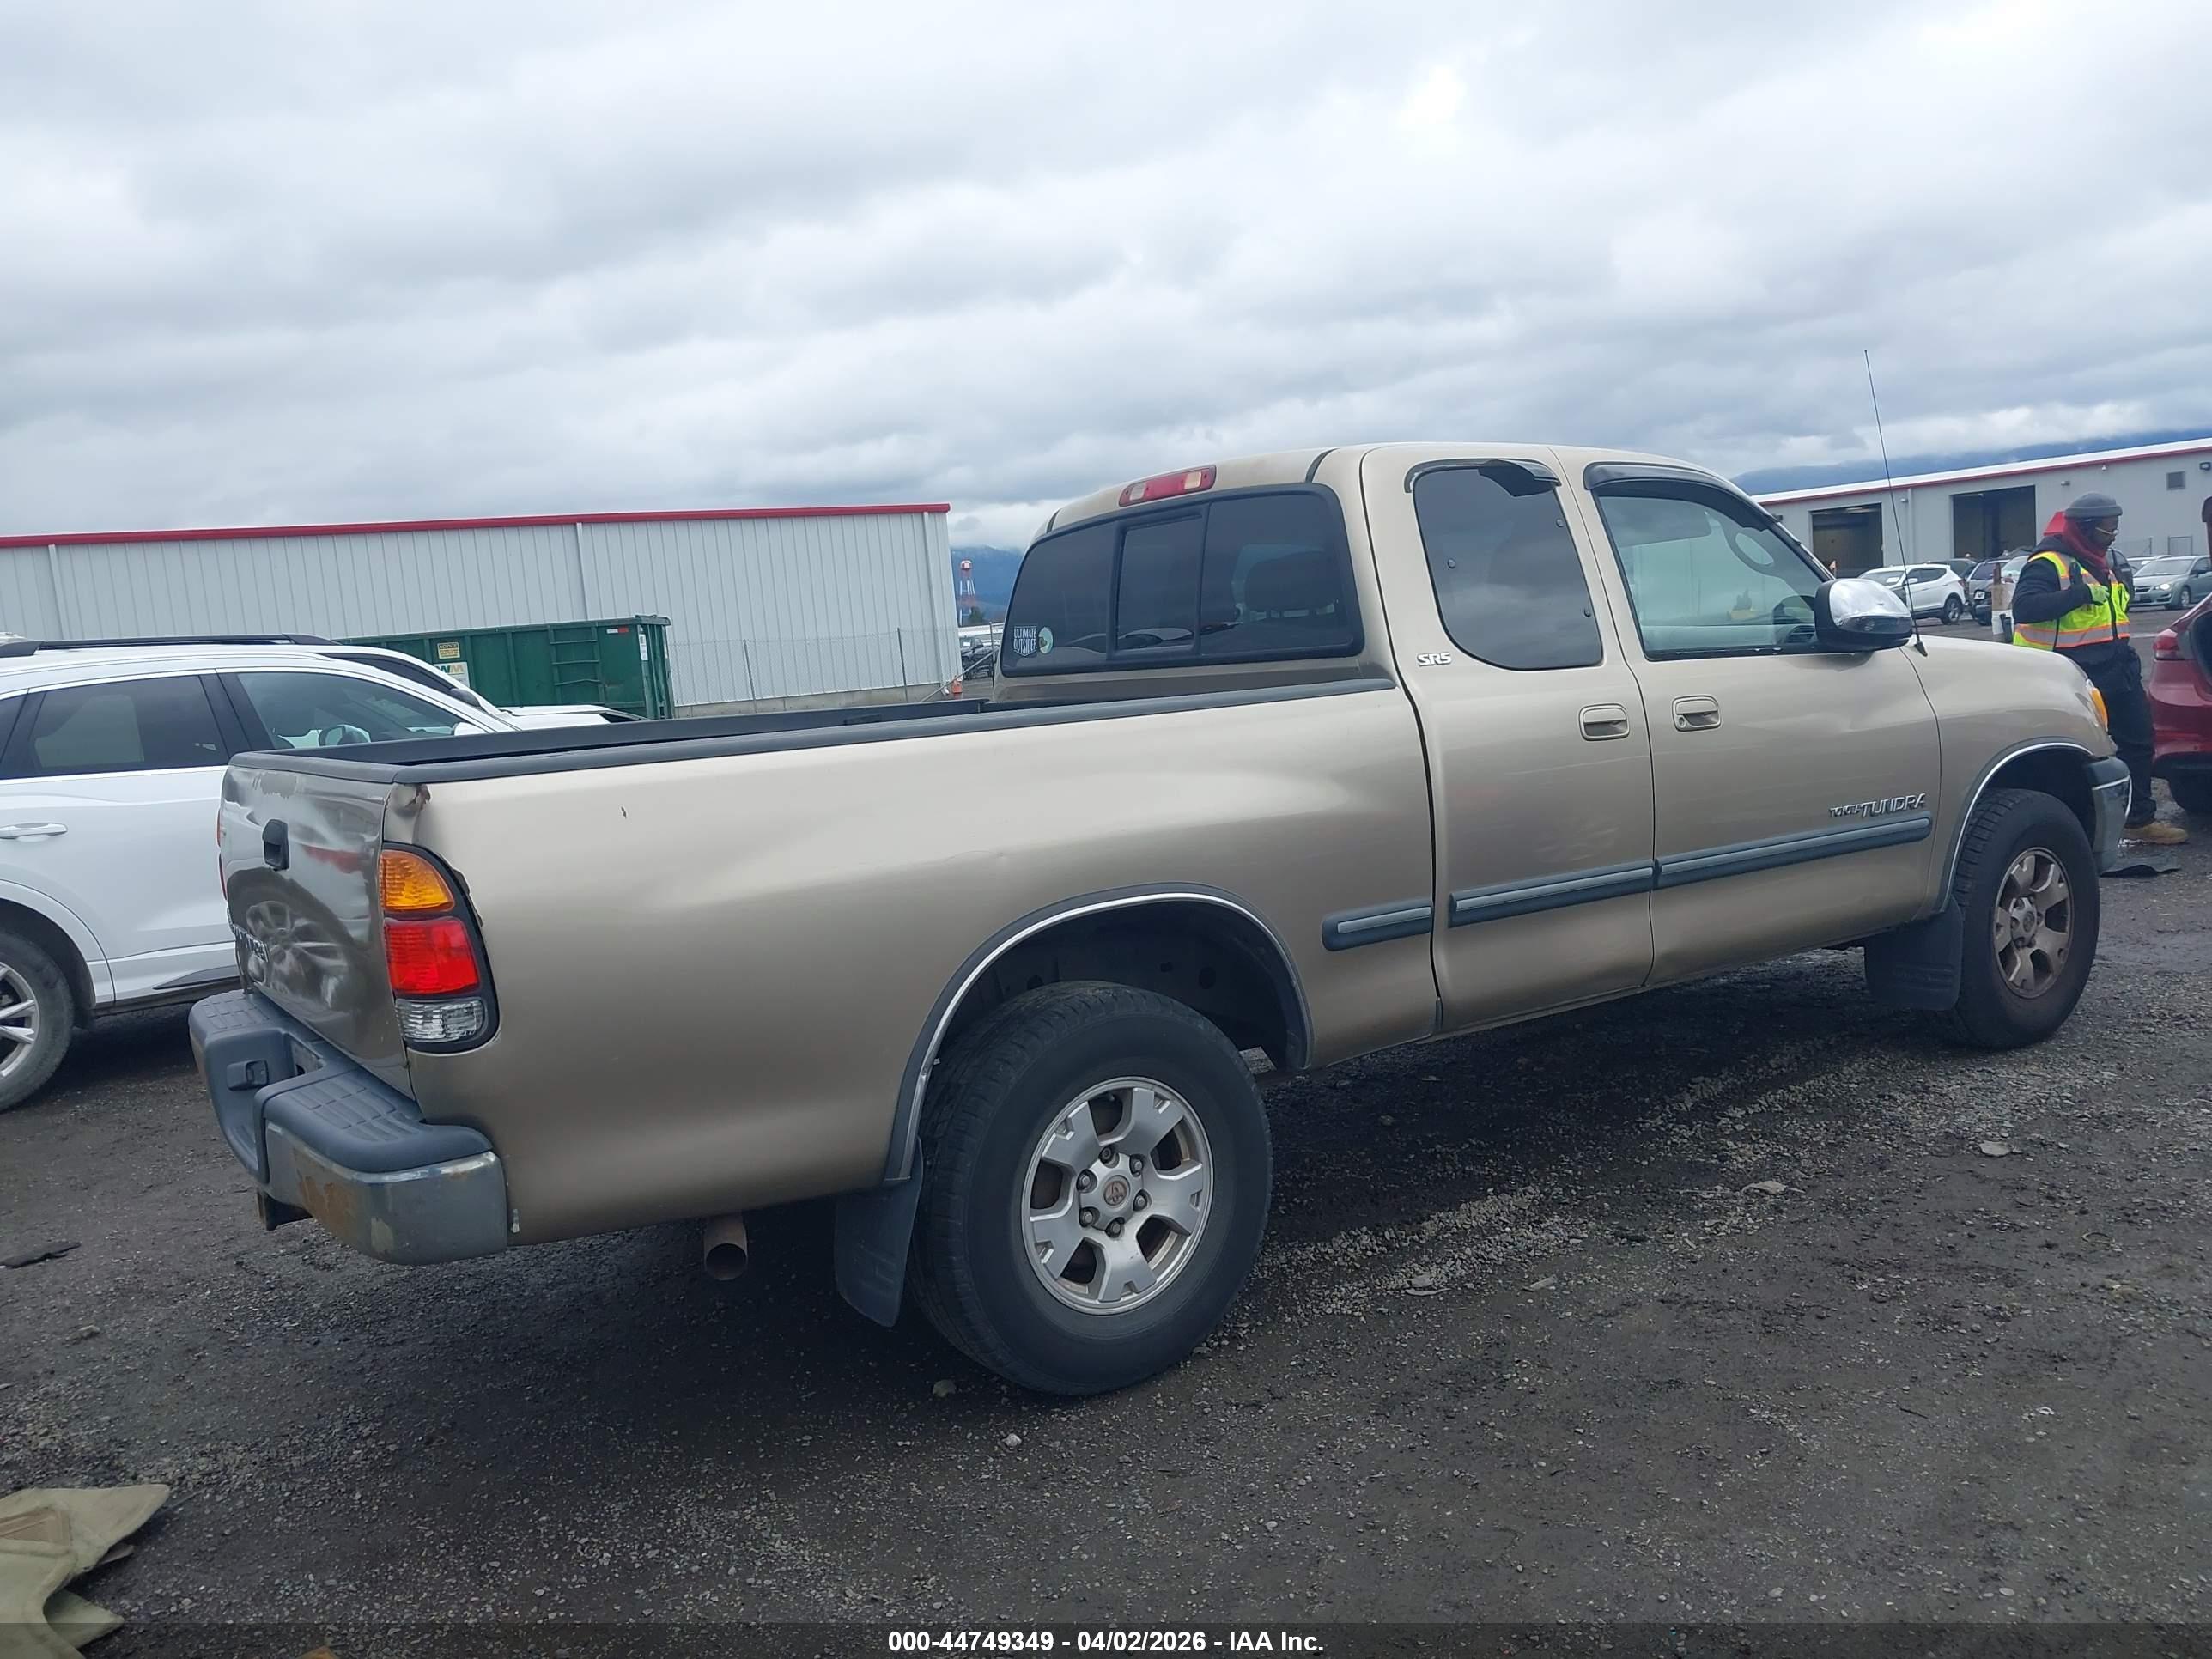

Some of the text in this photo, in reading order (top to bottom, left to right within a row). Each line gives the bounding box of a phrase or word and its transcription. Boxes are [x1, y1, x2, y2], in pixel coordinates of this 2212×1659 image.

[1013, 627, 1037, 638] ULTIMATE
[1013, 638, 1037, 654] OUTSIDER
[1417, 652, 1452, 667] SR5
[1860, 793, 1926, 817] TUNDRA
